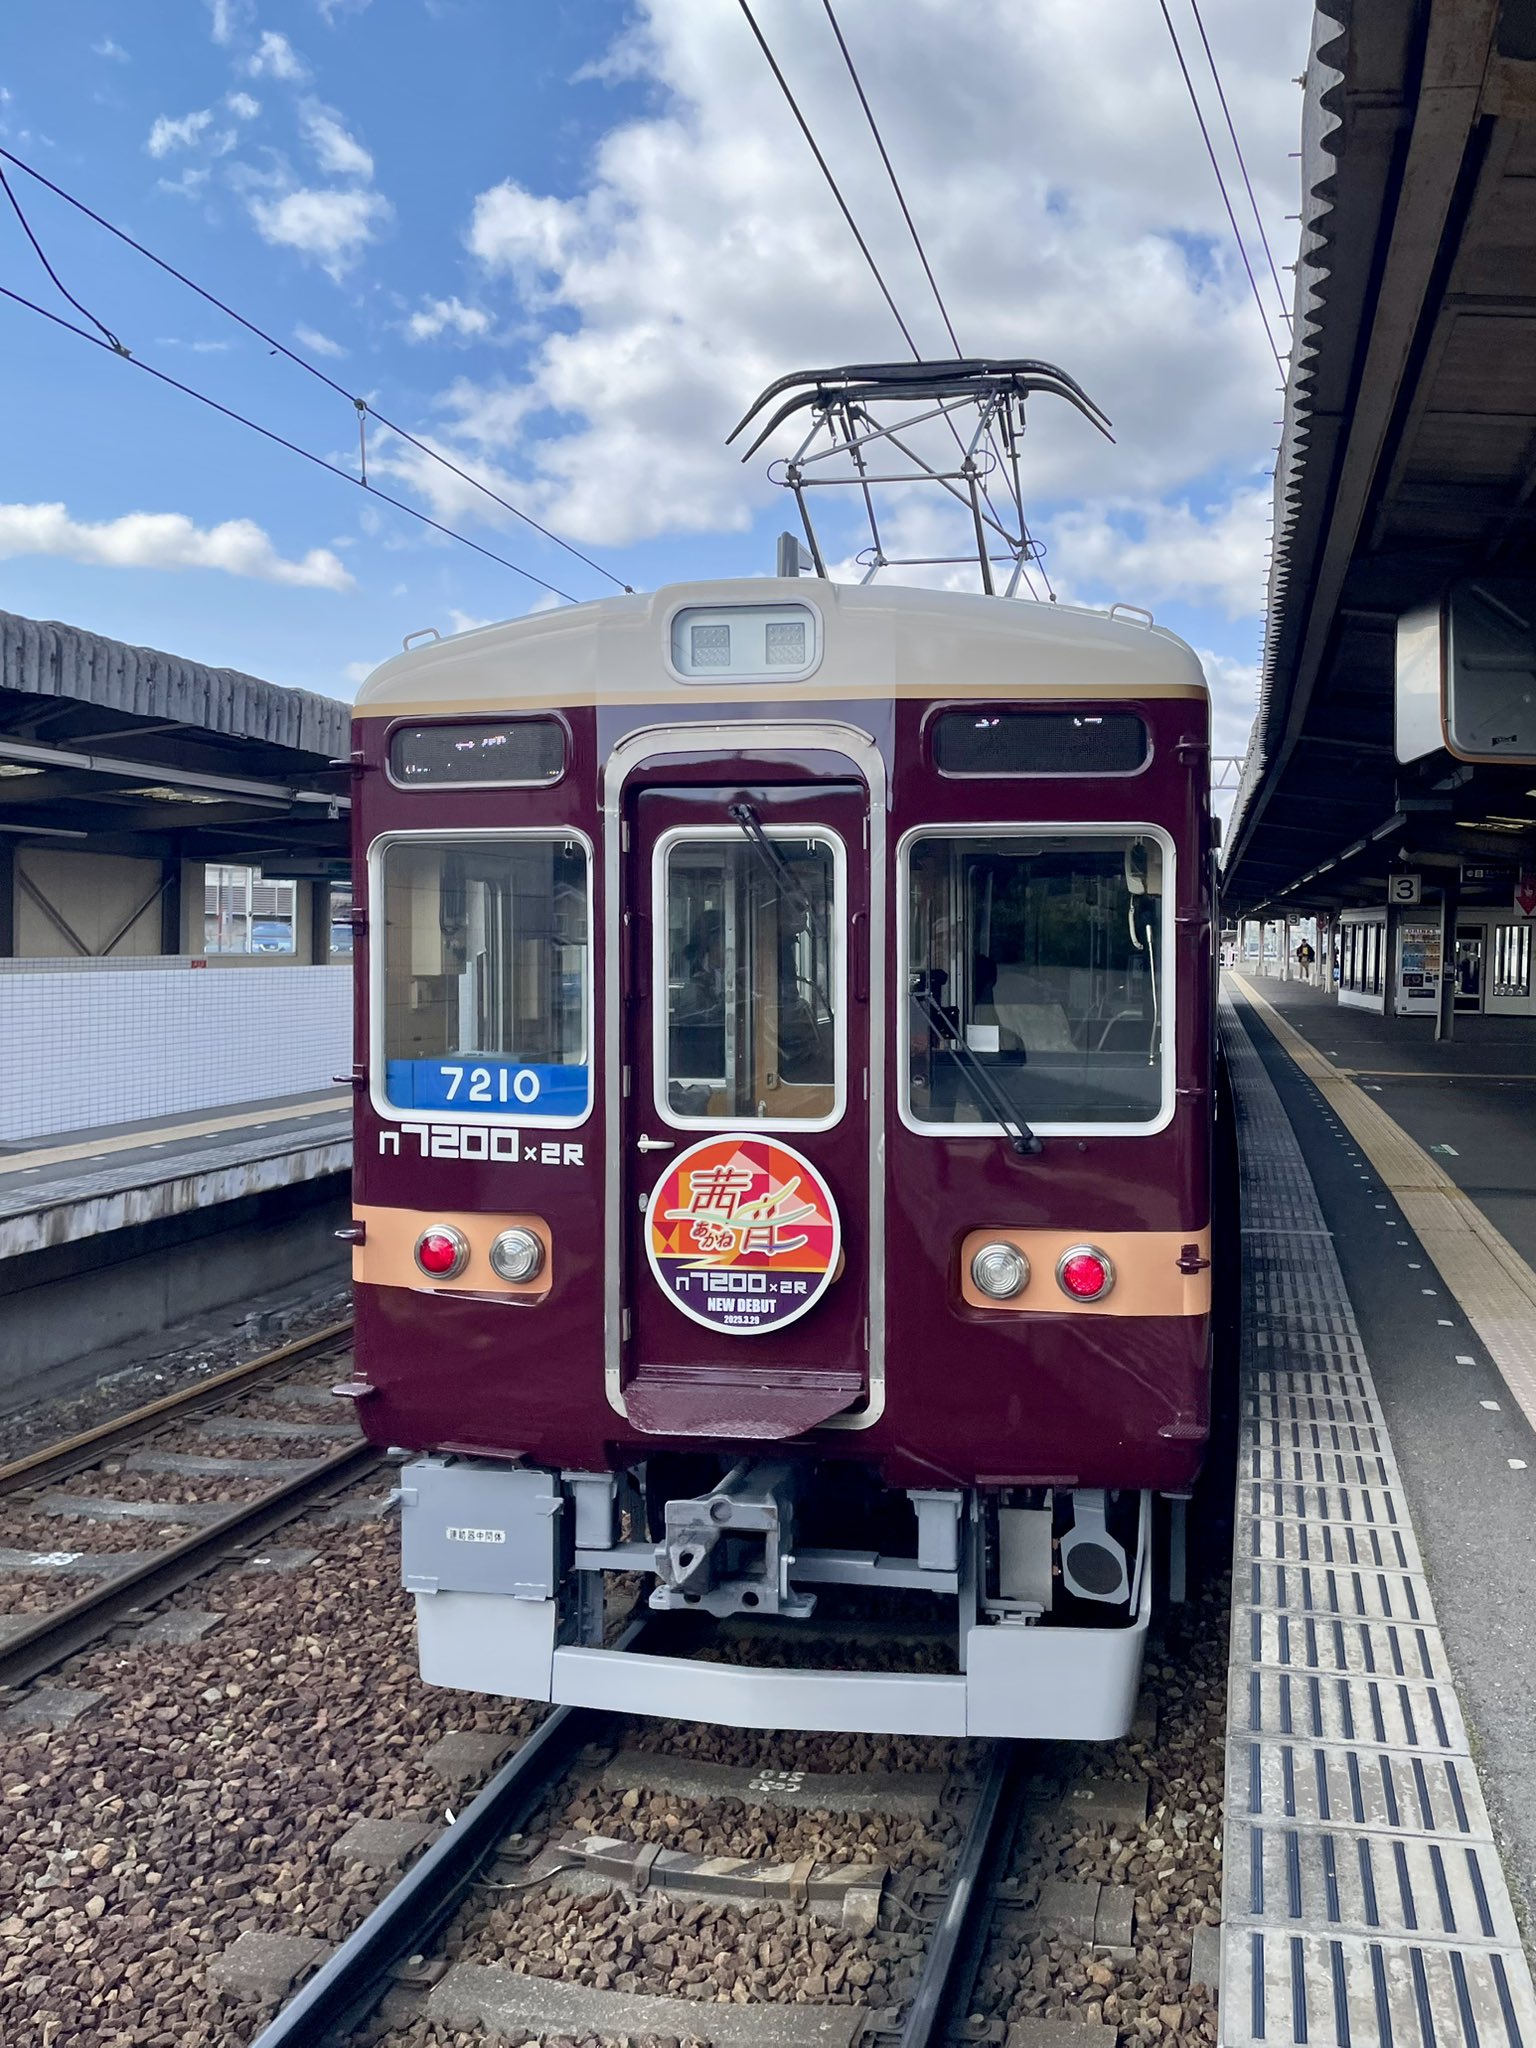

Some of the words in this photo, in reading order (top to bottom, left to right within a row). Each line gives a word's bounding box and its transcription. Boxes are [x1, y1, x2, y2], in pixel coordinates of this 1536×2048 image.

[1396, 879, 1414, 899] 3
[440, 1066, 541, 1103] 7210
[692, 1222, 735, 1249] あかね
[707, 1297, 735, 1312] NEW
[737, 1298, 777, 1314] DEBUT
[723, 1315, 760, 1325] 2025.3.29
